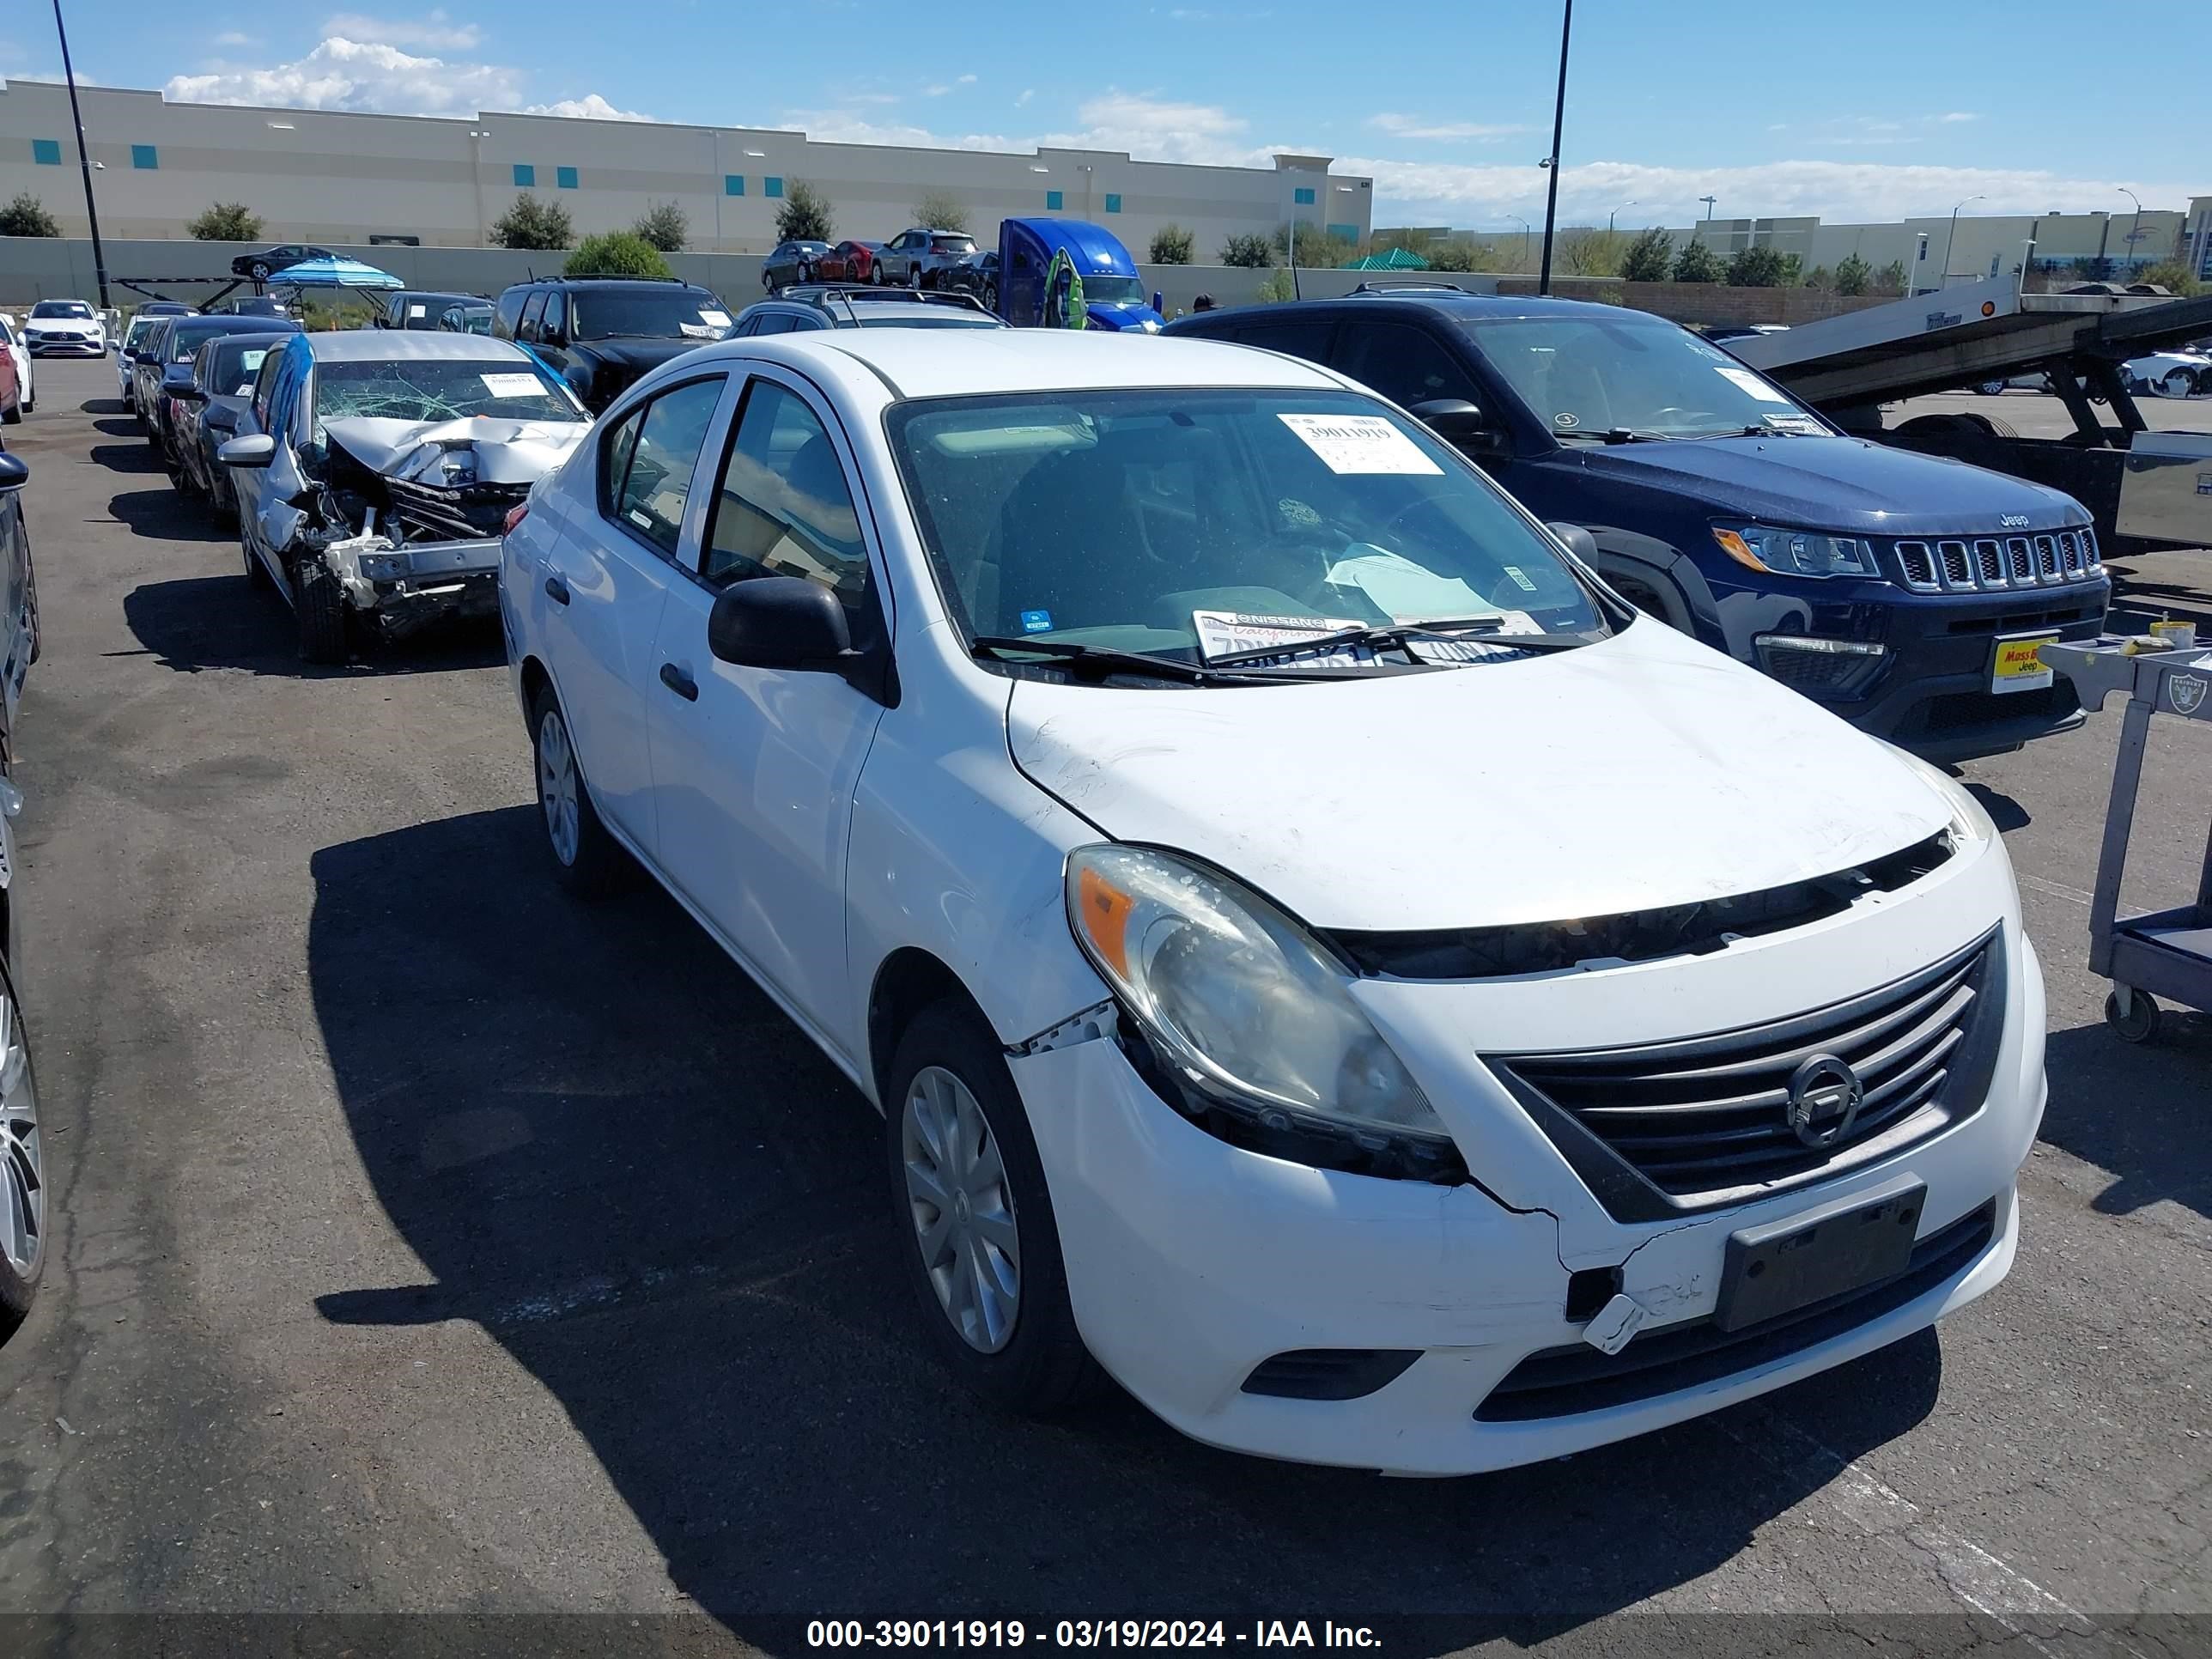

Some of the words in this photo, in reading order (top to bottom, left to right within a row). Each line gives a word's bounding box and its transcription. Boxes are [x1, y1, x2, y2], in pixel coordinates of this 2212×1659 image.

[1305, 427, 1391, 439] 39011919
[1999, 513, 2030, 528] Jeep
[1252, 615, 1313, 629] NISSAN
[2018, 661, 2038, 672] Jeep
